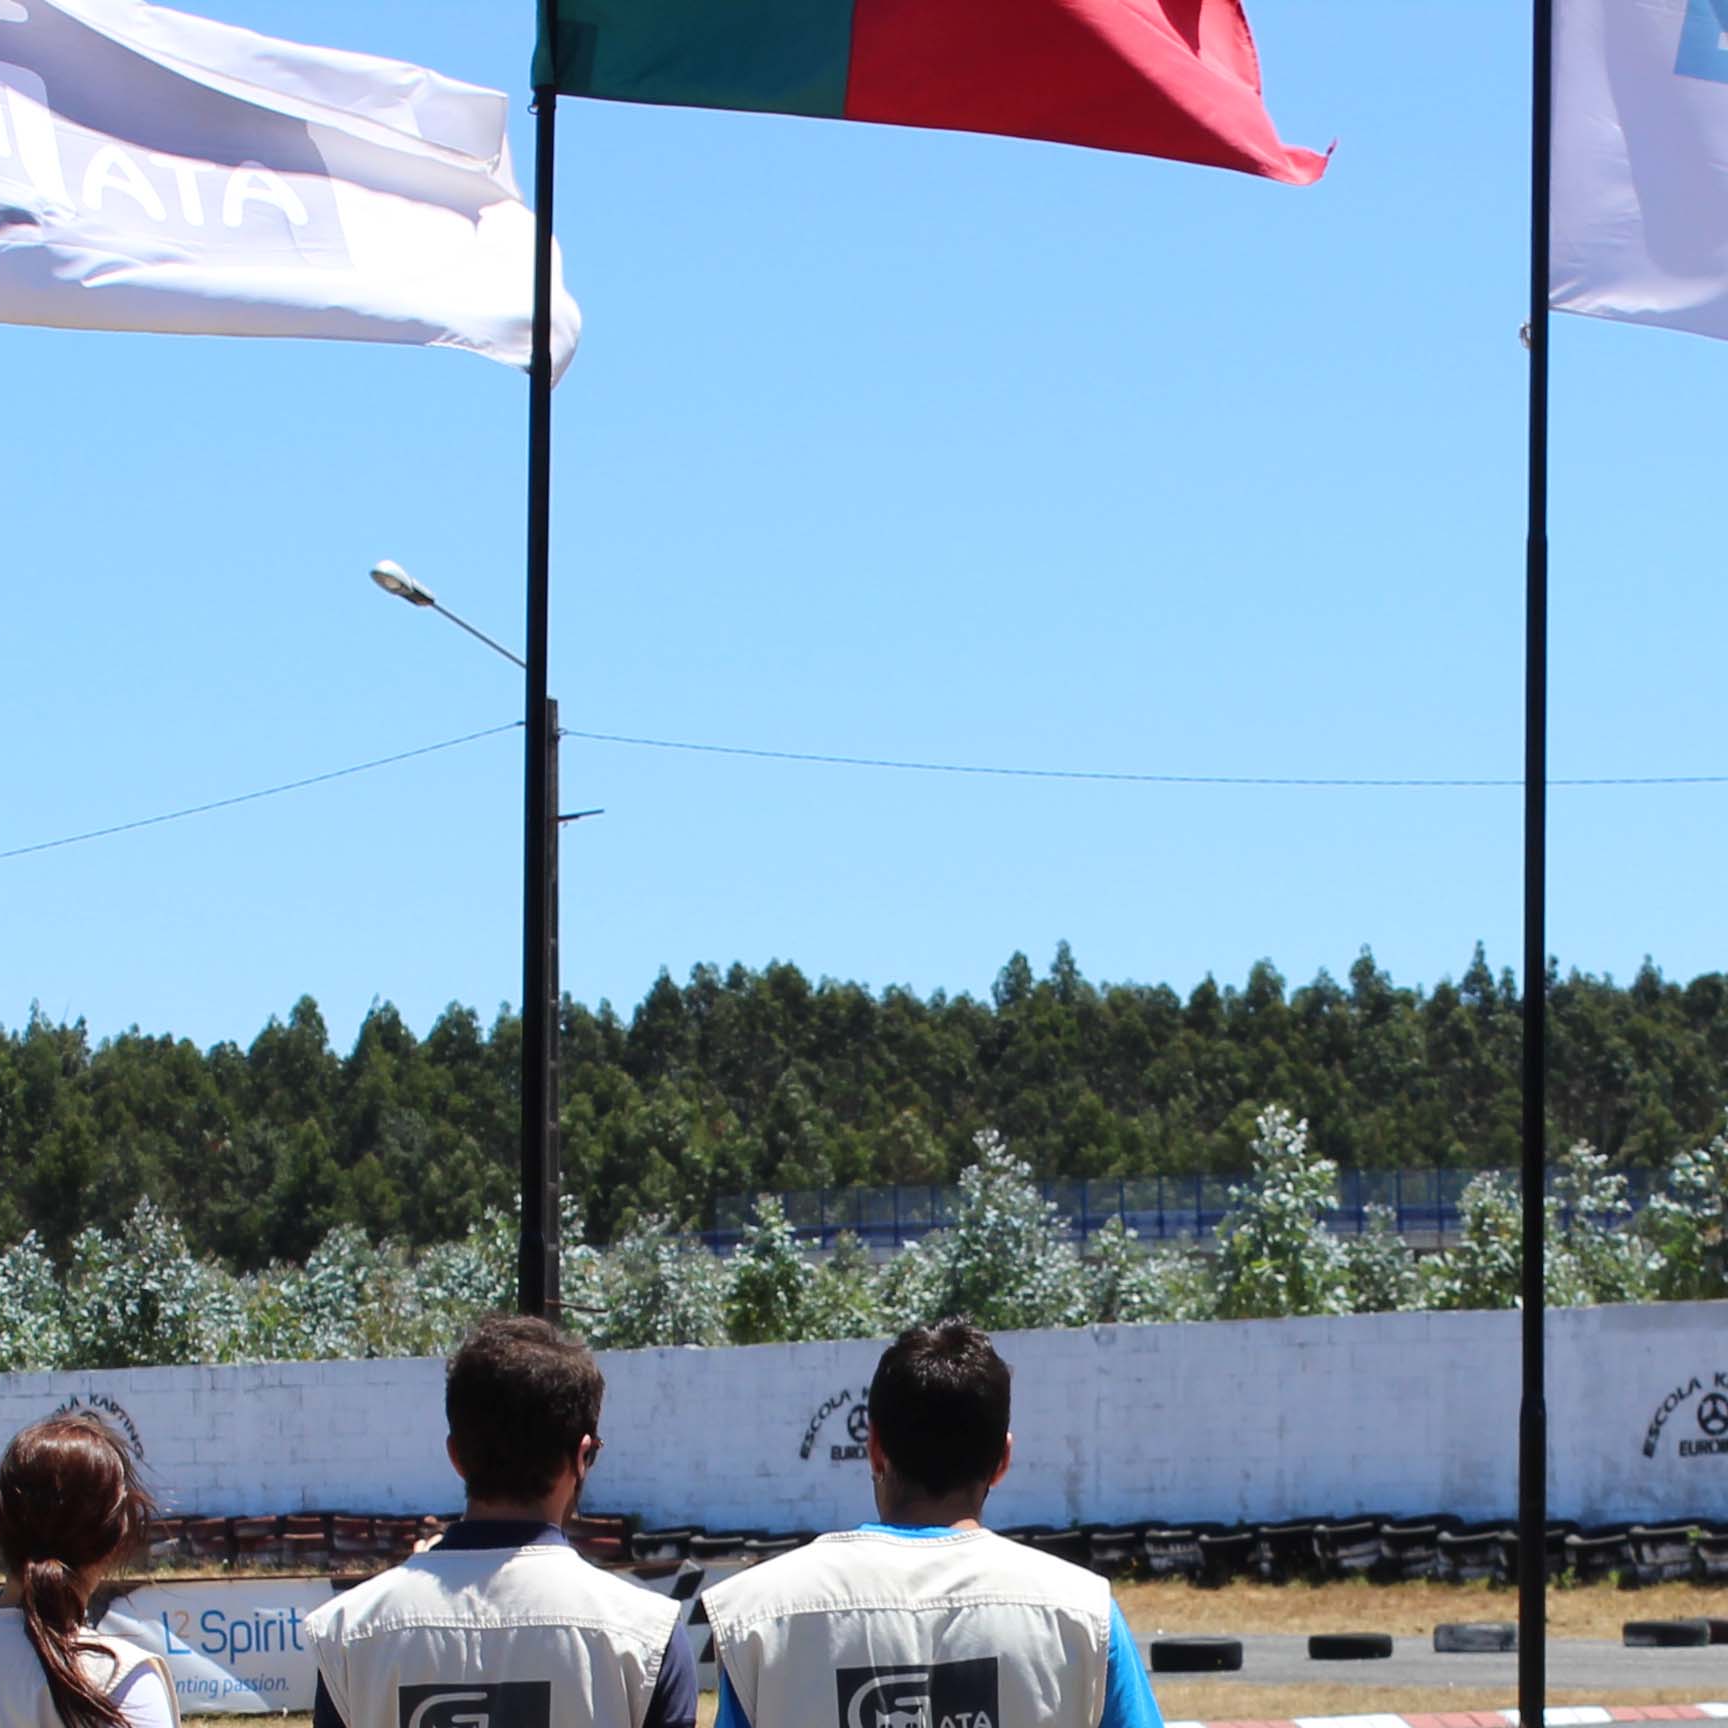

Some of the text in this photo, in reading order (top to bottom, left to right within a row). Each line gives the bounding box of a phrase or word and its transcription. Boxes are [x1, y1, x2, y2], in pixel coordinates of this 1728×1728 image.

[799, 1388, 852, 1460] ESCOLA
[1641, 1376, 1702, 1459] ESCOLA
[199, 1606, 305, 1665] Spirit
[222, 1672, 290, 1698] passion.
